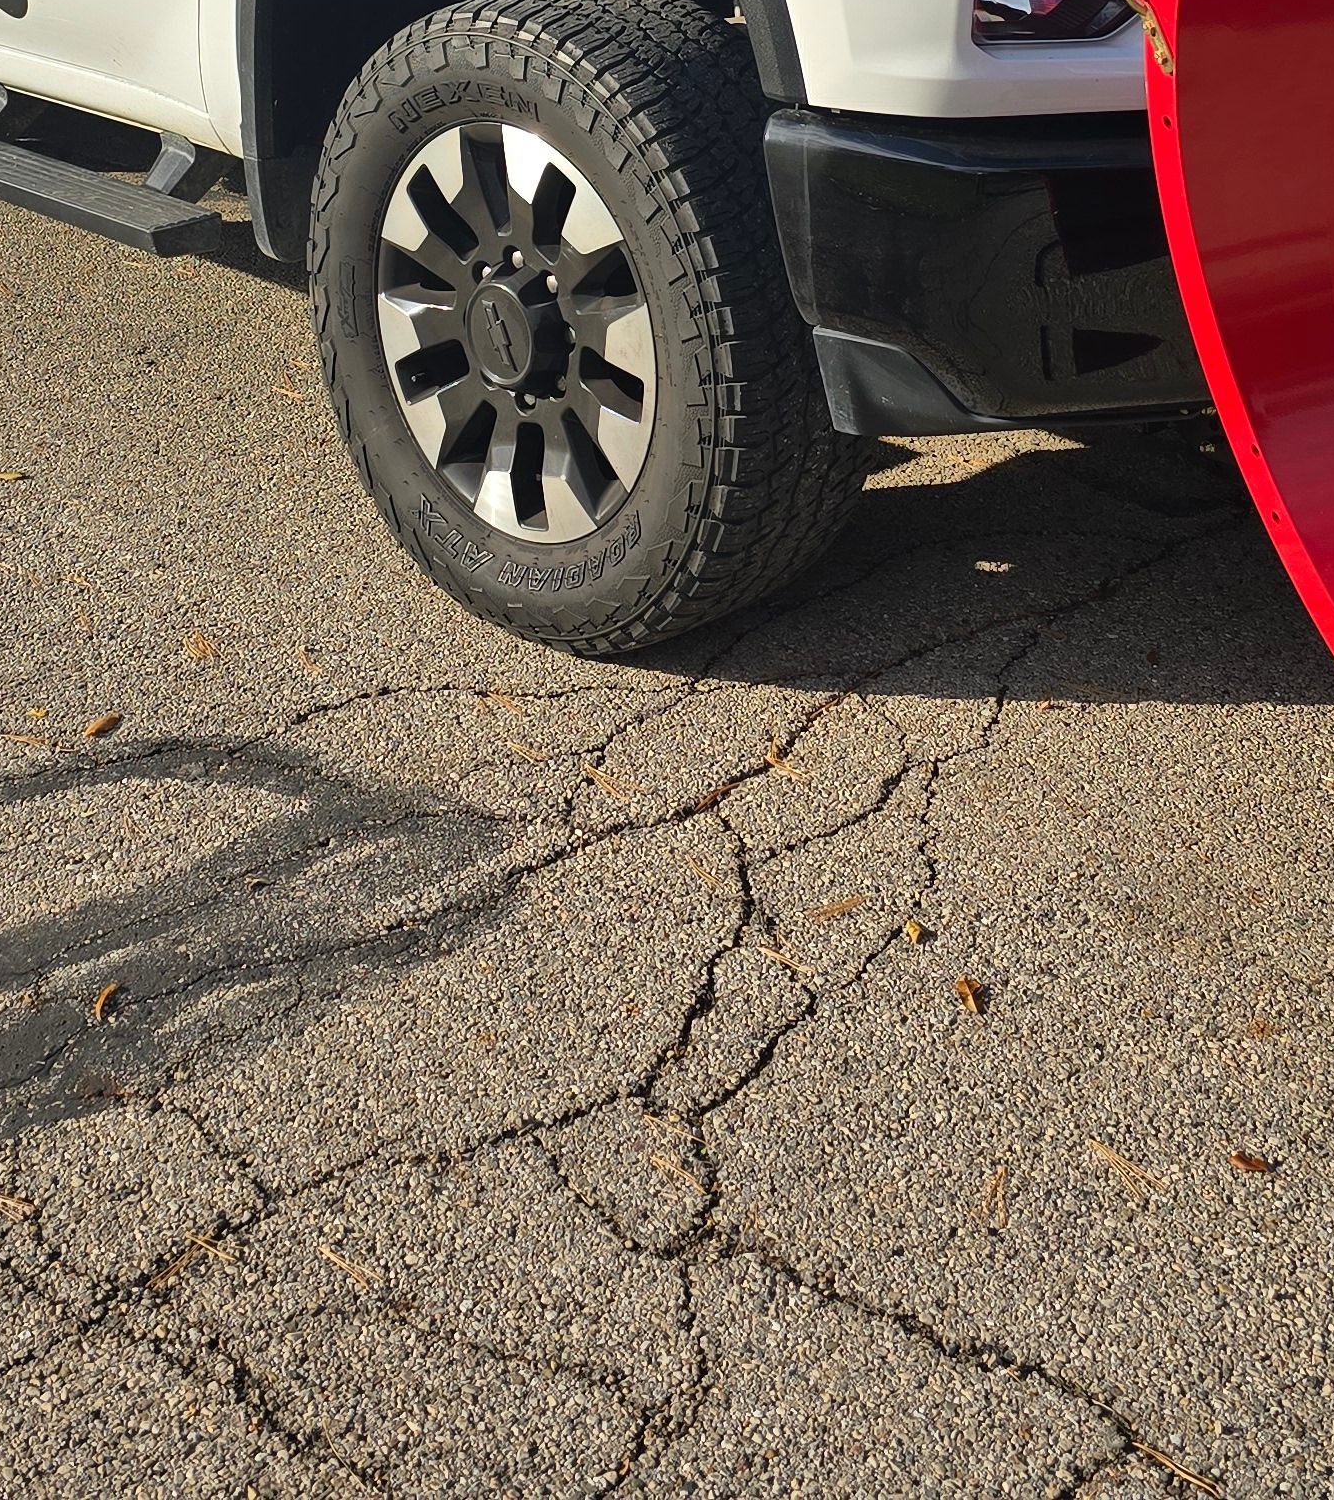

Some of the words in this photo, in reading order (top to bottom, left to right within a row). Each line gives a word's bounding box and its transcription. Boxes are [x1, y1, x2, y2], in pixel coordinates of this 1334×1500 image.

[388, 80, 540, 134] NEXEN
[411, 493, 495, 572] ATX
[498, 510, 642, 592] ROADIAN
